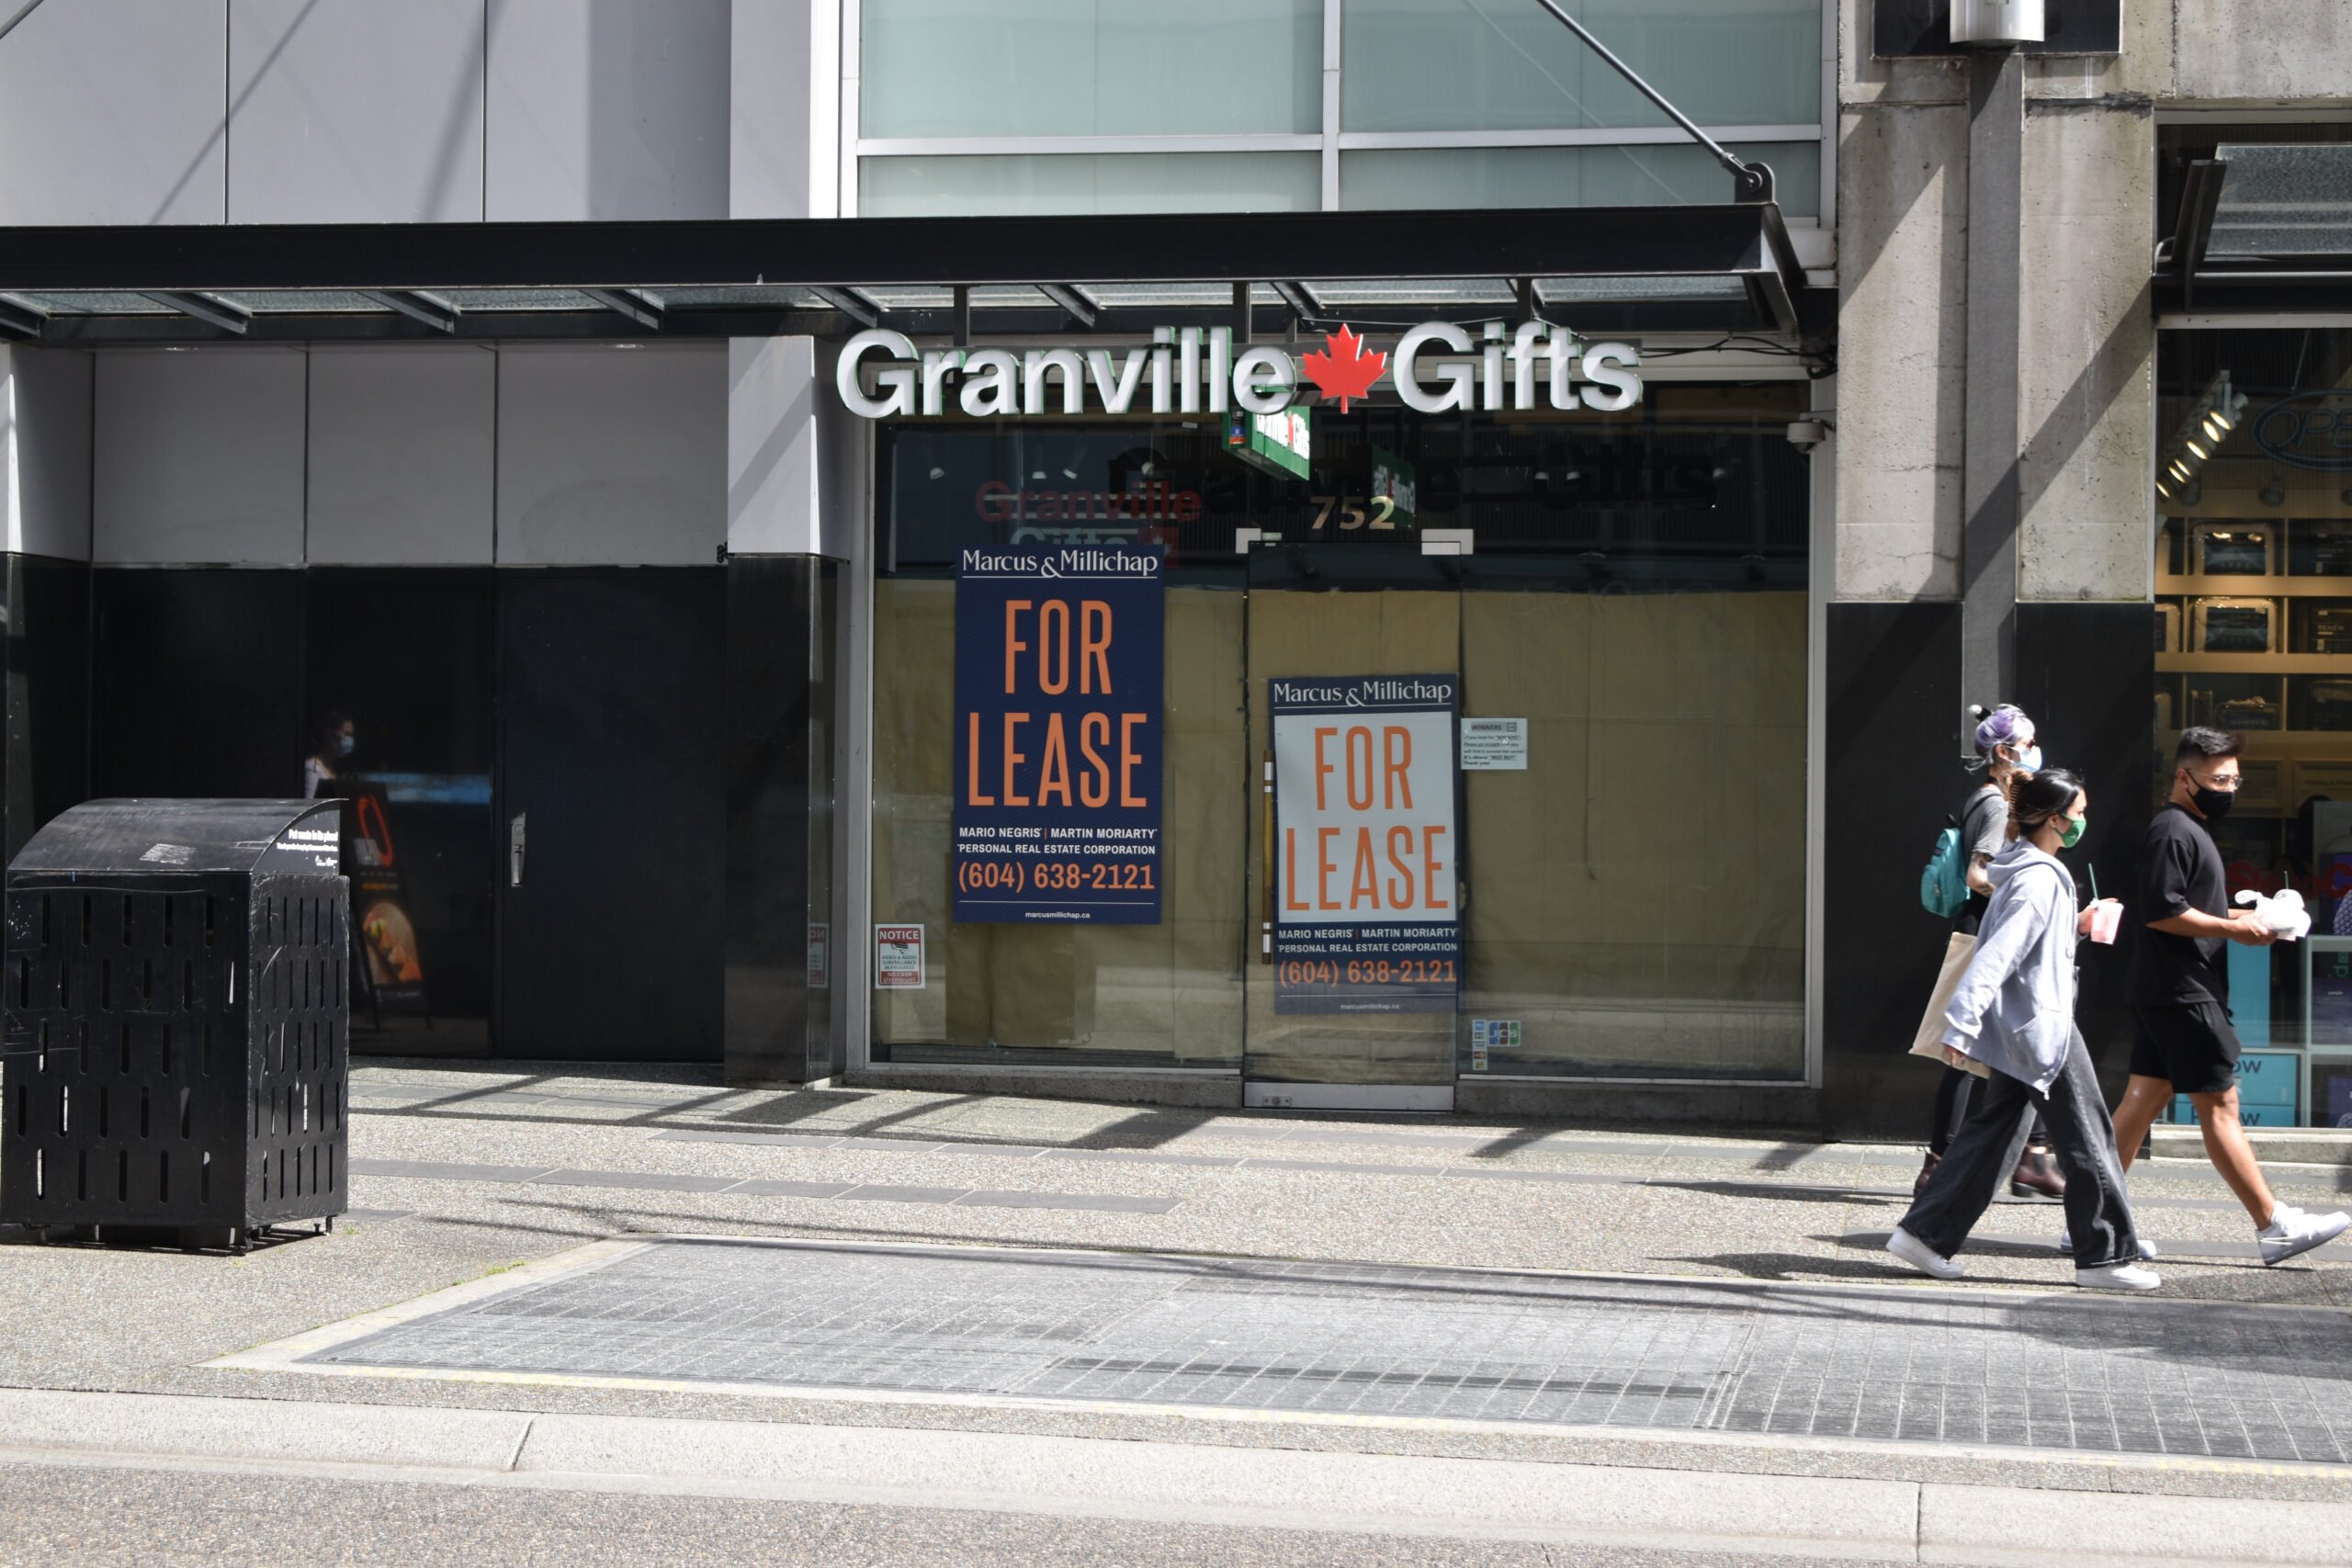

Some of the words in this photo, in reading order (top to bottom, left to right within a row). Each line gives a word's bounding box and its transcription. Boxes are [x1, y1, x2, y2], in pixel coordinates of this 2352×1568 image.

[837, 326, 1297, 419] Granville
[1393, 321, 1644, 413] Gifts
[975, 479, 1203, 523] Granville
[1310, 496, 1396, 531] 752
[963, 549, 1038, 571] Marcus
[1041, 557, 1062, 578] &
[1060, 549, 1159, 577] Millichap
[1005, 599, 1113, 695] FOR
[1273, 682, 1343, 703] Marcus
[1345, 688, 1367, 707] &
[1363, 680, 1453, 704] Millichap
[968, 712, 1148, 808] LEASE
[1315, 726, 1414, 811] FOR
[959, 827, 996, 838] MARIO
[1050, 828, 1093, 839] MARTIN
[1015, 844, 1041, 853] REAL
[1044, 844, 1080, 854] ESTATE
[1083, 845, 1156, 855] CORPORATION
[959, 861, 1025, 893] (604)
[1034, 863, 1156, 890] 638-2121
[1286, 825, 1449, 911] LEASE
[1024, 910, 1091, 919] marcusmillichap.ca
[879, 931, 920, 941] NOTICE
[1278, 929, 1311, 939] MARIO
[1362, 929, 1400, 938] MARTIN
[1329, 943, 1353, 953] REAL
[1355, 943, 1389, 953] ESTATE
[1392, 942, 1458, 952] CORPORATION
[1279, 960, 1340, 988] (604)
[1347, 959, 1457, 983] 638-2121
